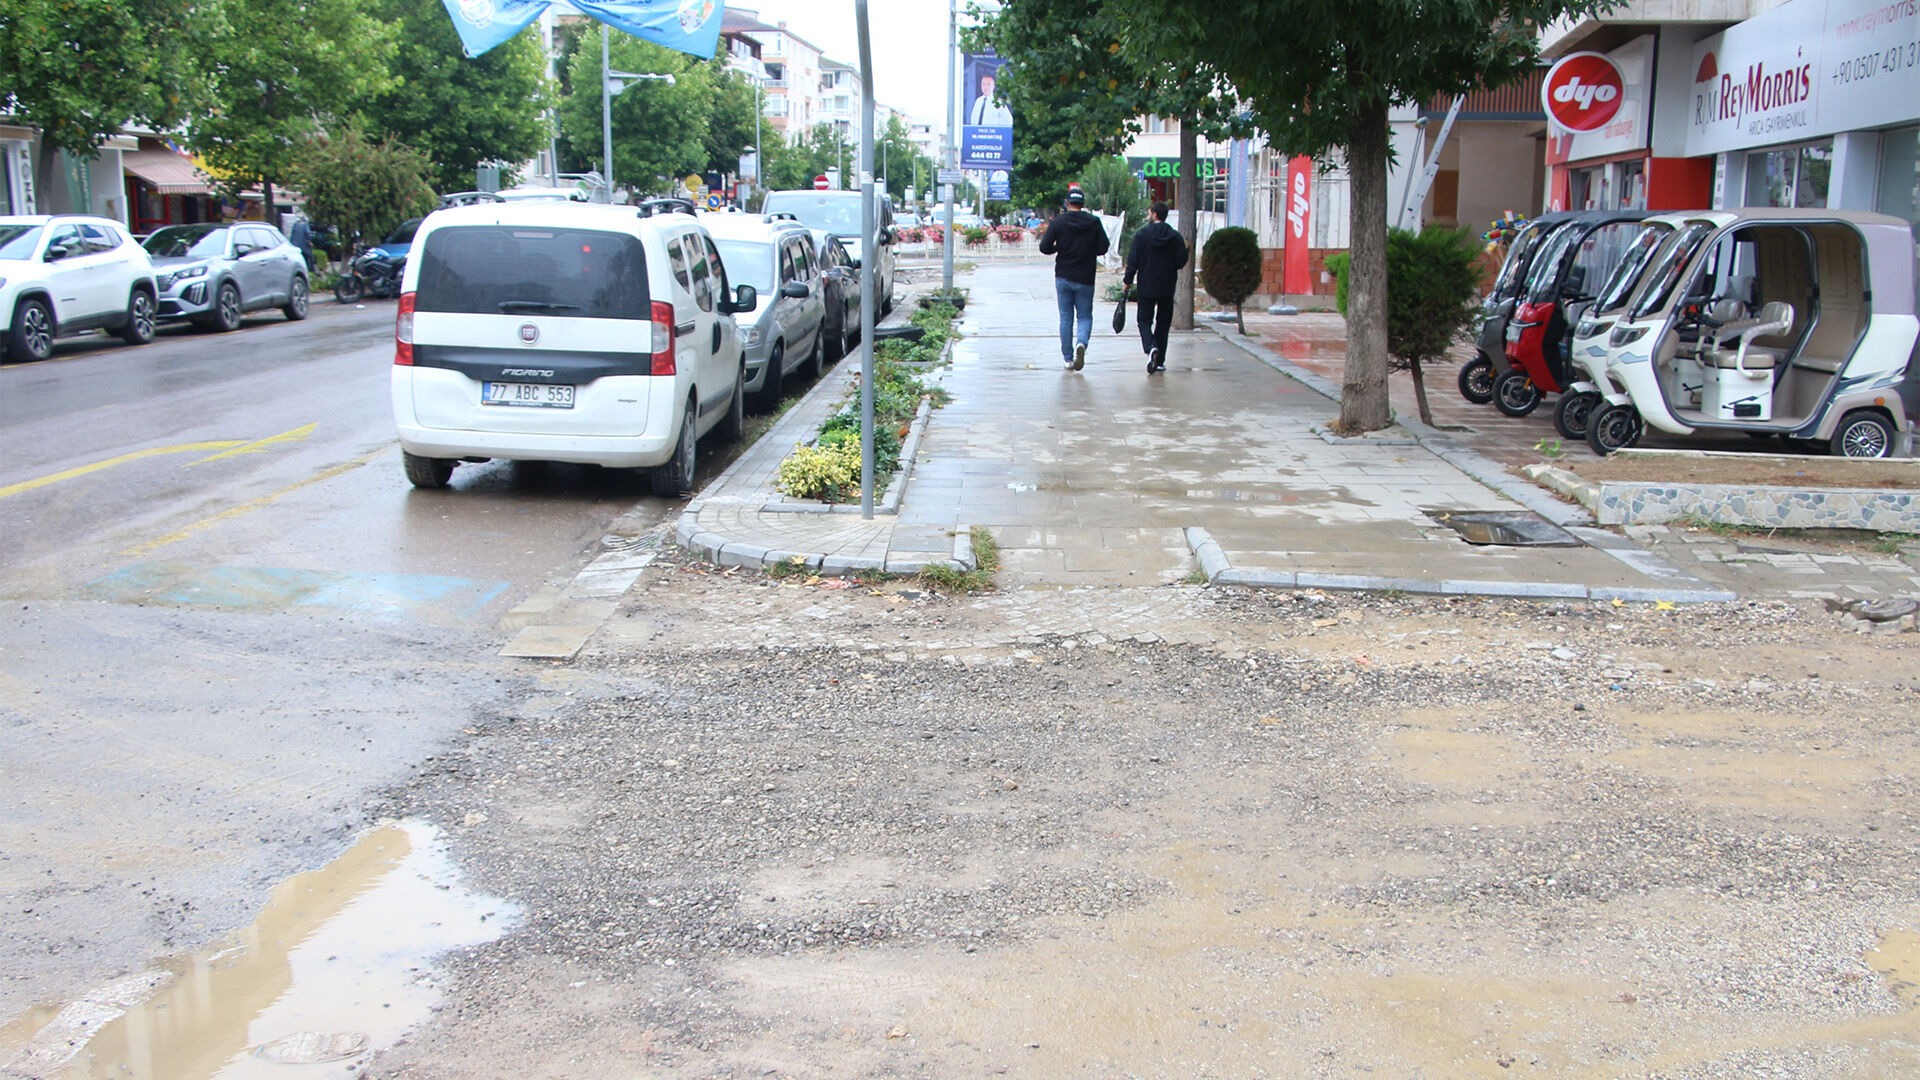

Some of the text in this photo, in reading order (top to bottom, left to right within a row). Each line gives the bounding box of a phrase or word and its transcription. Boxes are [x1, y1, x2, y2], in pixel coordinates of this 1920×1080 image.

[1832, 60, 1852, 85] +90
[1854, 52, 1880, 81] 0507
[1882, 46, 1903, 73] 431
[1553, 75, 1617, 111] dyo
[1287, 172, 1309, 238] dyo
[501, 368, 554, 378] FIORINO
[491, 384, 572, 402] 77 ABC 553
